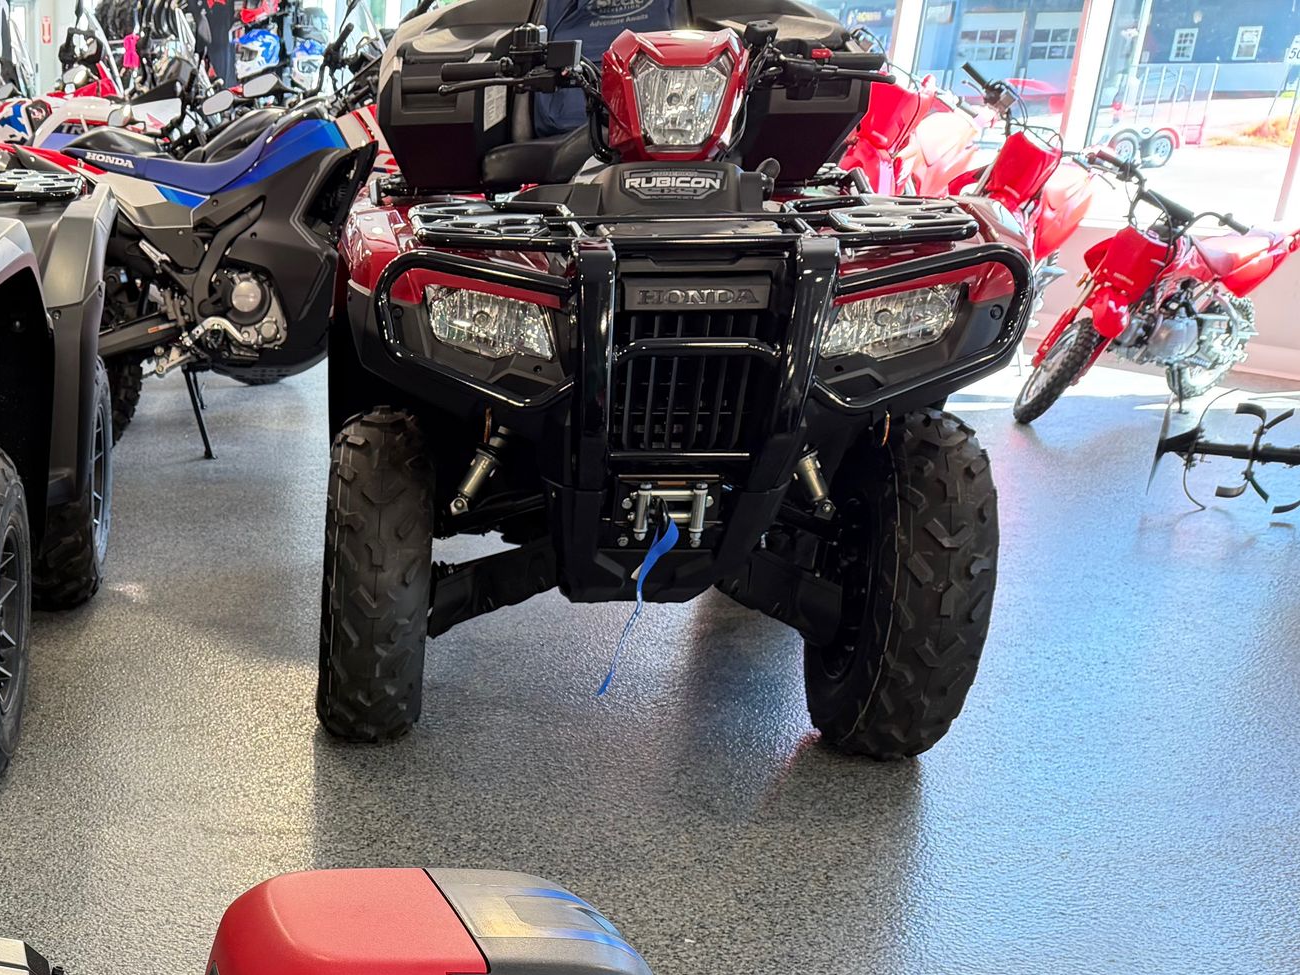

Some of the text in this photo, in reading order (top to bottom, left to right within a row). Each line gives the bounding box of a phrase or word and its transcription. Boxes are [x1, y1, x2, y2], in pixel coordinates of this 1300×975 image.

[589, 14, 649, 28] Adventure Awaits
[85, 152, 134, 169] HONDA
[625, 176, 721, 190] RUBICON
[637, 288, 760, 305] HONDA
